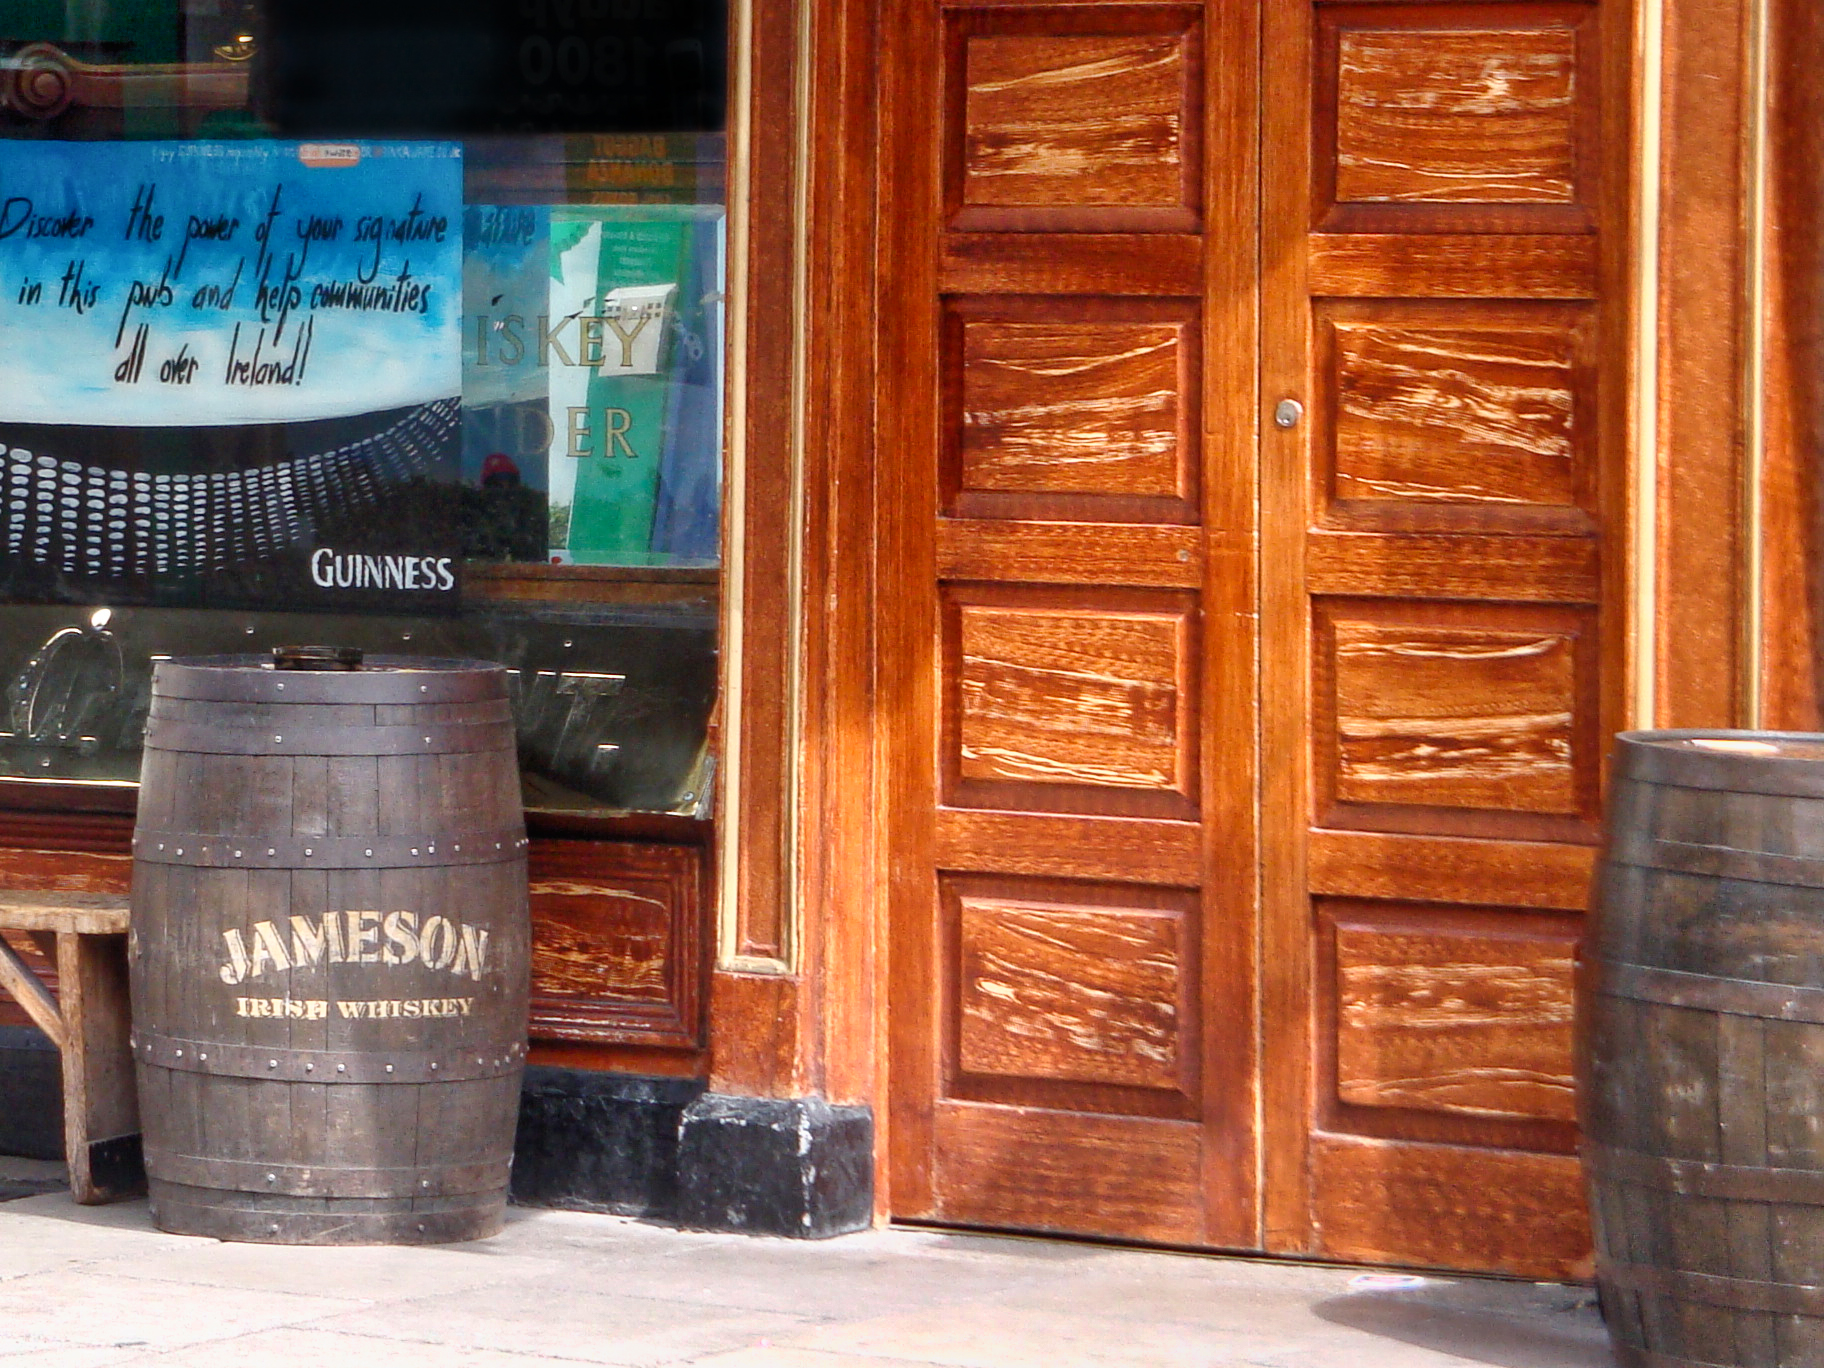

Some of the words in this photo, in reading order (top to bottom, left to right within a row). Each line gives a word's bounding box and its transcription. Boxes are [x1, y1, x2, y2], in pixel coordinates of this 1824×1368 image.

[125, 182, 166, 243] the
[173, 214, 240, 281] power
[254, 182, 283, 279] of
[295, 213, 344, 282] your
[353, 191, 449, 285] signature
[17, 276, 43, 307] in
[58, 259, 102, 315] this
[114, 254, 174, 350] pub
[191, 256, 246, 311] and
[254, 252, 303, 348] help
[309, 258, 432, 315] communities
[114, 322, 151, 384] all
[159, 343, 200, 385] over
[475, 314, 651, 367] ISKEY
[311, 547, 455, 592] GUINNESS
[219, 909, 489, 985] JAMESON
[236, 996, 328, 1021] IRISH
[337, 996, 475, 1020] WHISKEY
